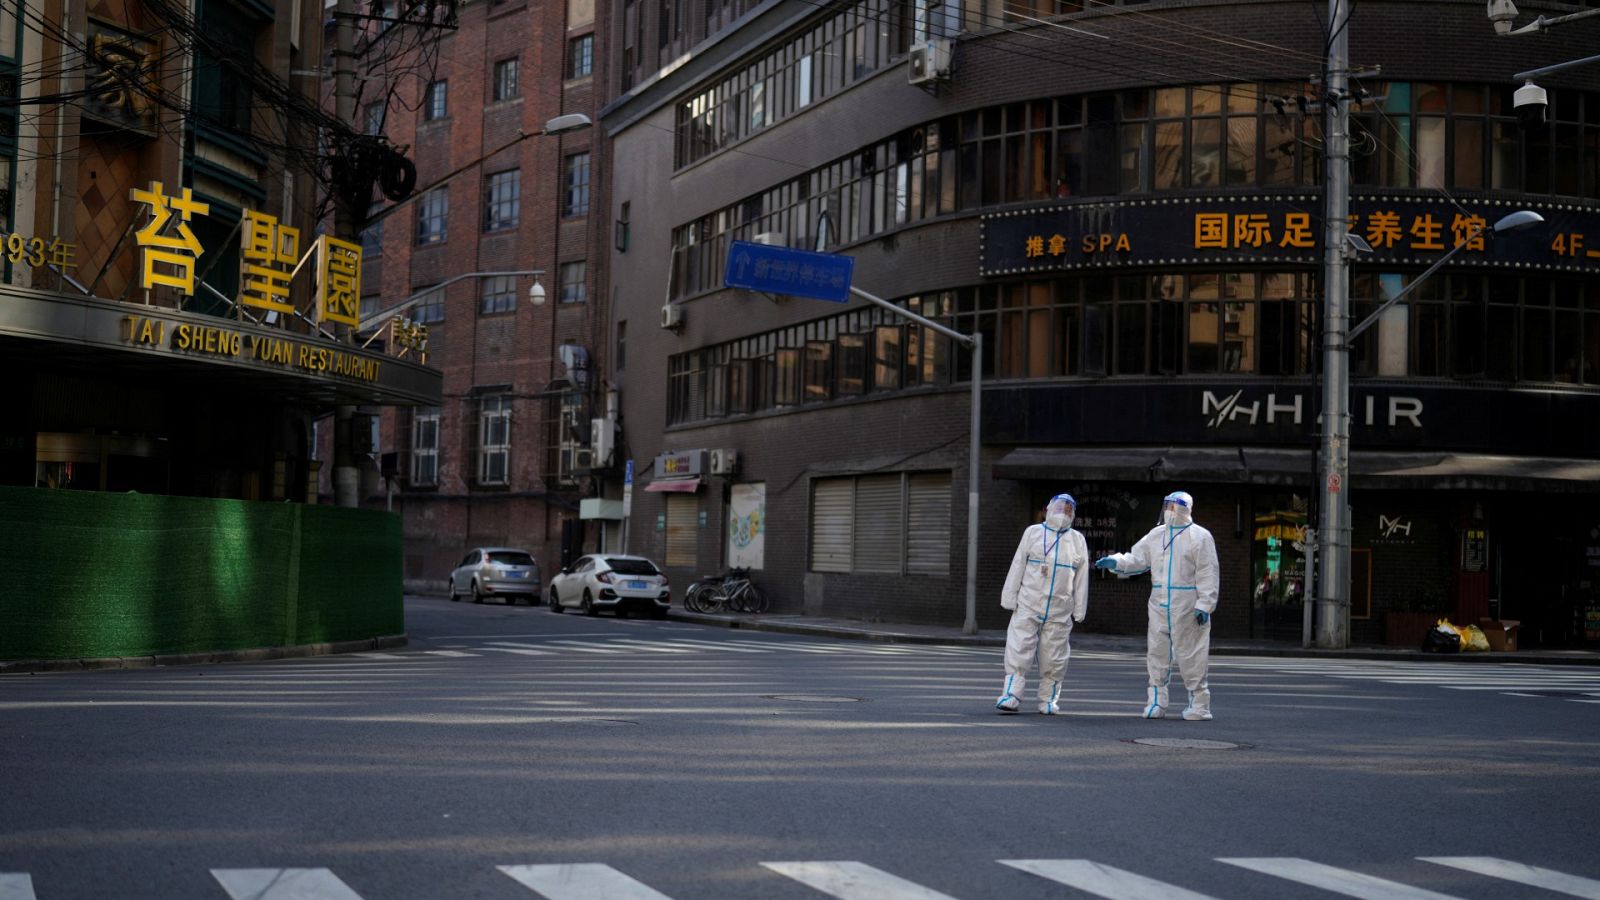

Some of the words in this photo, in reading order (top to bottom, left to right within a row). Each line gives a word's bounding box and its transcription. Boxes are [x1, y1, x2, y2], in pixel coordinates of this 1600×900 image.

[1026, 235, 1066, 257] 推拿
[1084, 234, 1131, 251] SPA
[1194, 211, 1488, 251] 国际足养生馆
[0, 232, 78, 273] 93年
[127, 315, 165, 345] TAI
[178, 323, 241, 357] SHENG
[250, 338, 294, 365] YUAN
[299, 344, 381, 382] RESTAURANT
[1267, 394, 1424, 427] HIR
[1080, 529, 1114, 538] HAMPOO
